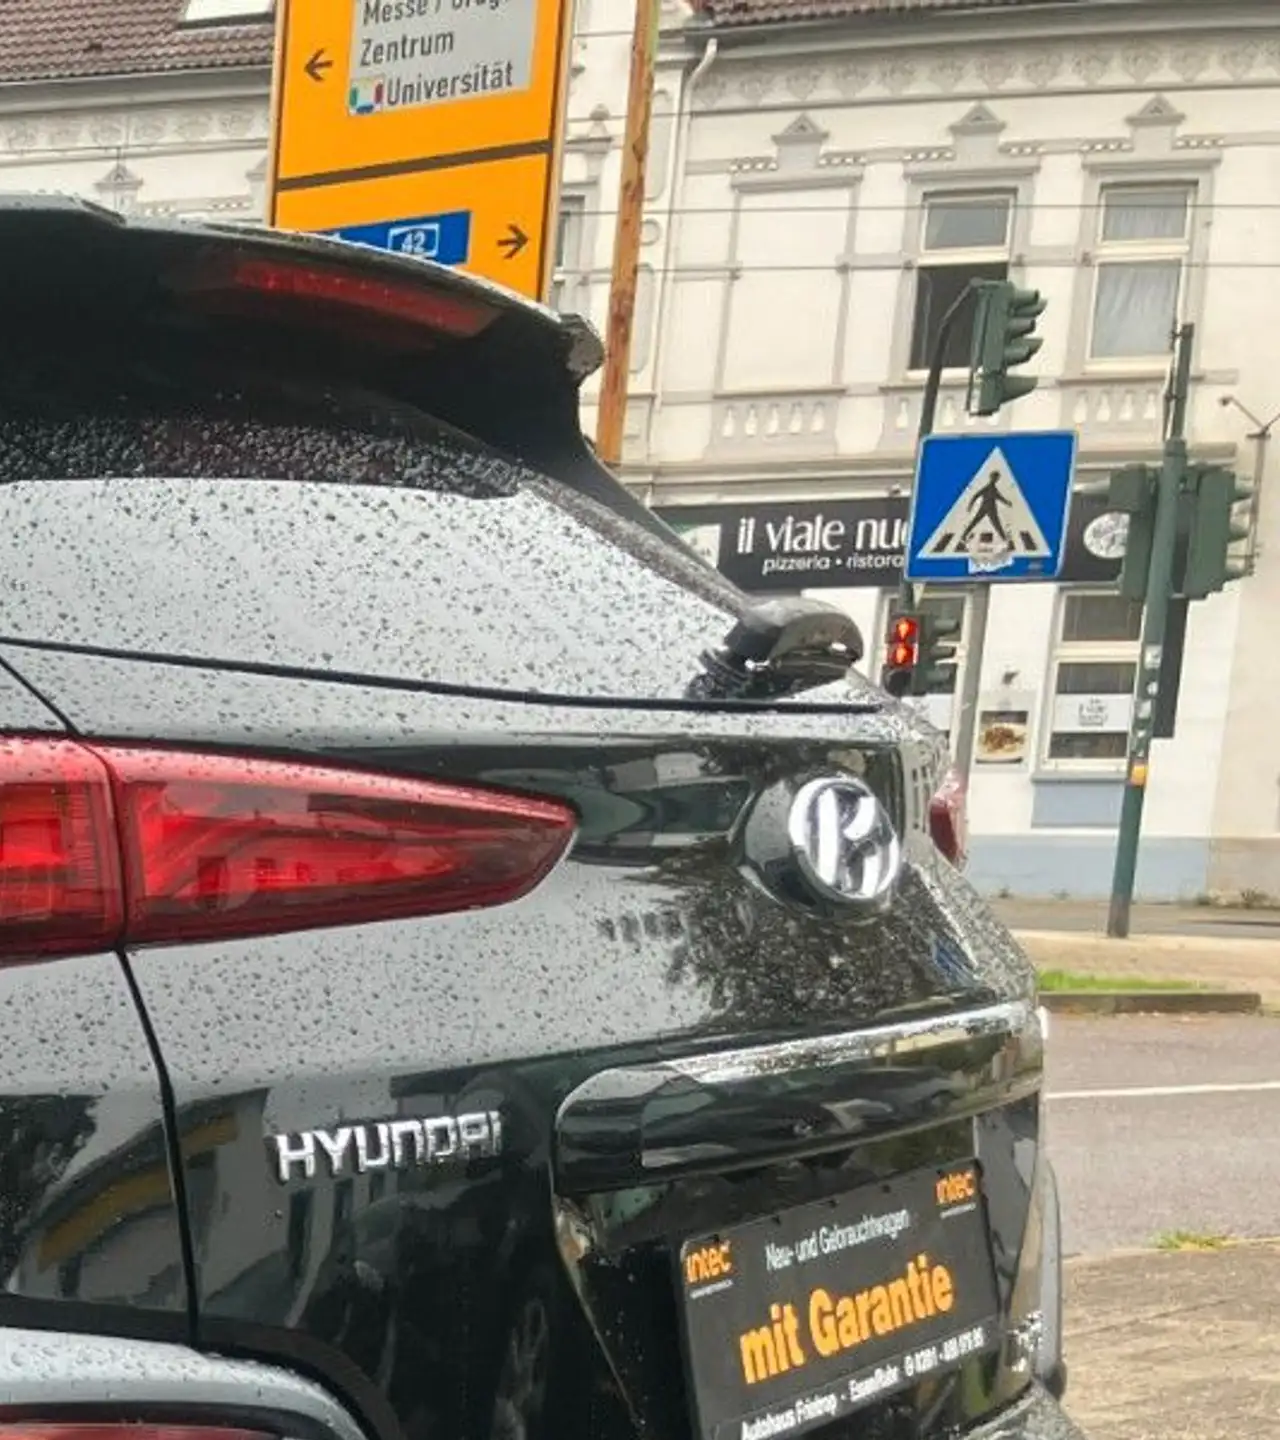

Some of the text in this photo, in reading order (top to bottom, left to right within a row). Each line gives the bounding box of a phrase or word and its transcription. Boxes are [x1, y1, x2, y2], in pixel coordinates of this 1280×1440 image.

[360, 31, 454, 67] Zentrum
[387, 60, 513, 106] Universität
[401, 230, 426, 254] 42
[737, 517, 756, 553] il
[766, 514, 845, 551] viale
[762, 553, 830, 575] pizzeria
[274, 1110, 503, 1182] HYUNDAI
[795, 1231, 818, 1262] und
[740, 1303, 804, 1384] mit
[809, 1252, 953, 1357] Garantie
